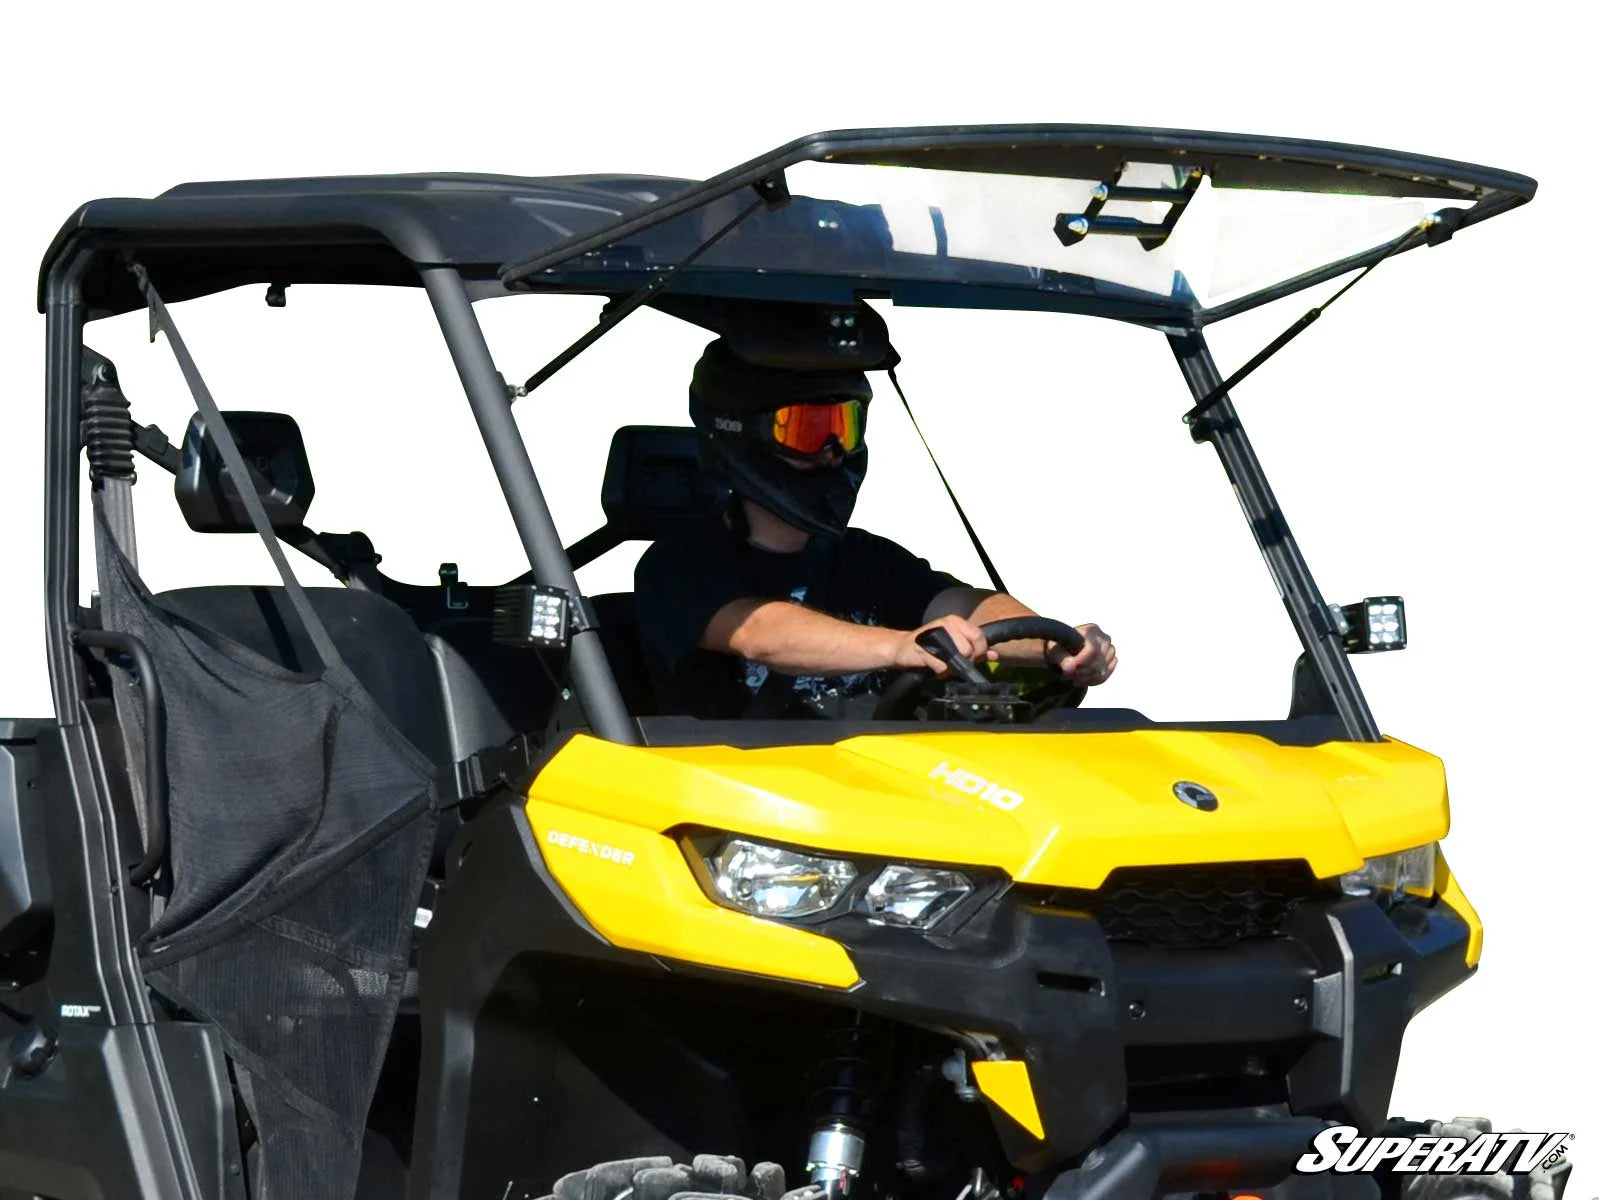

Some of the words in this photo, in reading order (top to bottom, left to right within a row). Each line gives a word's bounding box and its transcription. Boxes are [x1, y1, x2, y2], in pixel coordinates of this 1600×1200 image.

[930, 762, 1024, 810] HD10
[548, 830, 635, 865] DEFENDER
[61, 1004, 89, 1017] ROTAX
